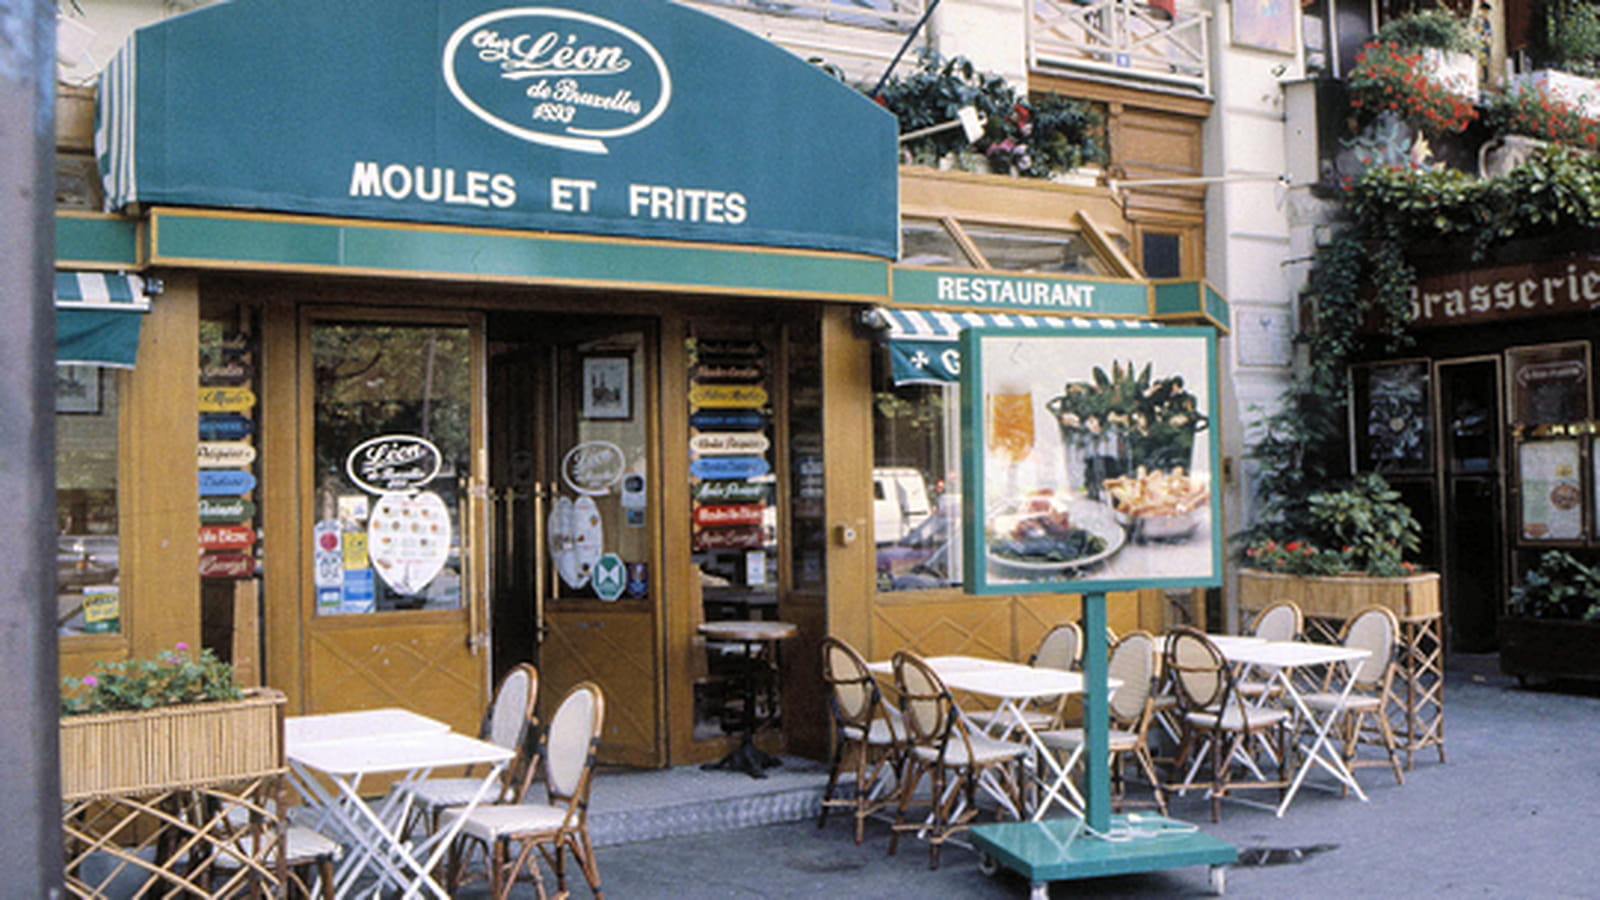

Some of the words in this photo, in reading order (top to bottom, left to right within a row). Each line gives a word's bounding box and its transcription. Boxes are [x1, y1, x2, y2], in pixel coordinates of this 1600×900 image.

[501, 32, 631, 80] Léon
[526, 79, 552, 99] de
[552, 78, 641, 115] Bruxelles
[349, 161, 516, 208] MOULES
[550, 177, 597, 212] ET
[628, 183, 748, 224] FRITES
[937, 276, 1095, 308] RESTAURANT
